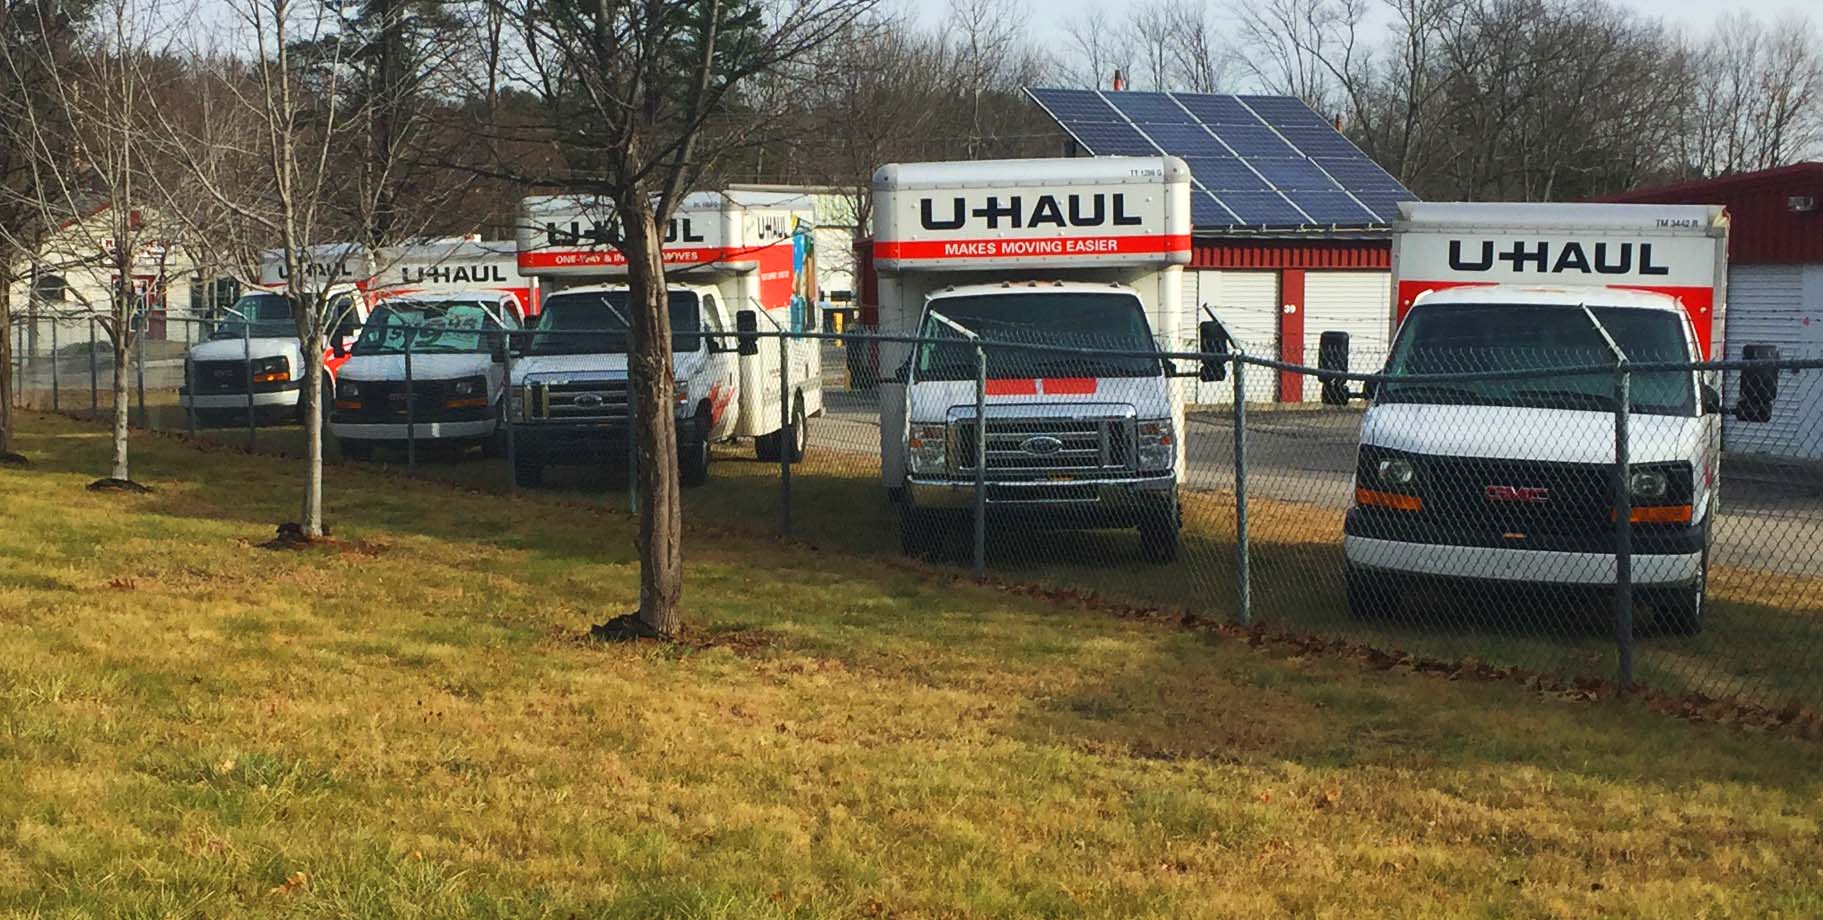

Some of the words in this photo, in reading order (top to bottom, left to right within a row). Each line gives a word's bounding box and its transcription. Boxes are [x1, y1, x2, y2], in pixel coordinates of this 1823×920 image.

[920, 193, 1142, 230] U-HAUL
[944, 242, 996, 255] MAKES
[1001, 240, 1062, 254] MOVING
[1066, 239, 1118, 252] EASIER
[1448, 240, 1669, 275] U-HAUL
[402, 265, 507, 284] U-HAUL
[1283, 304, 1296, 314] 39
